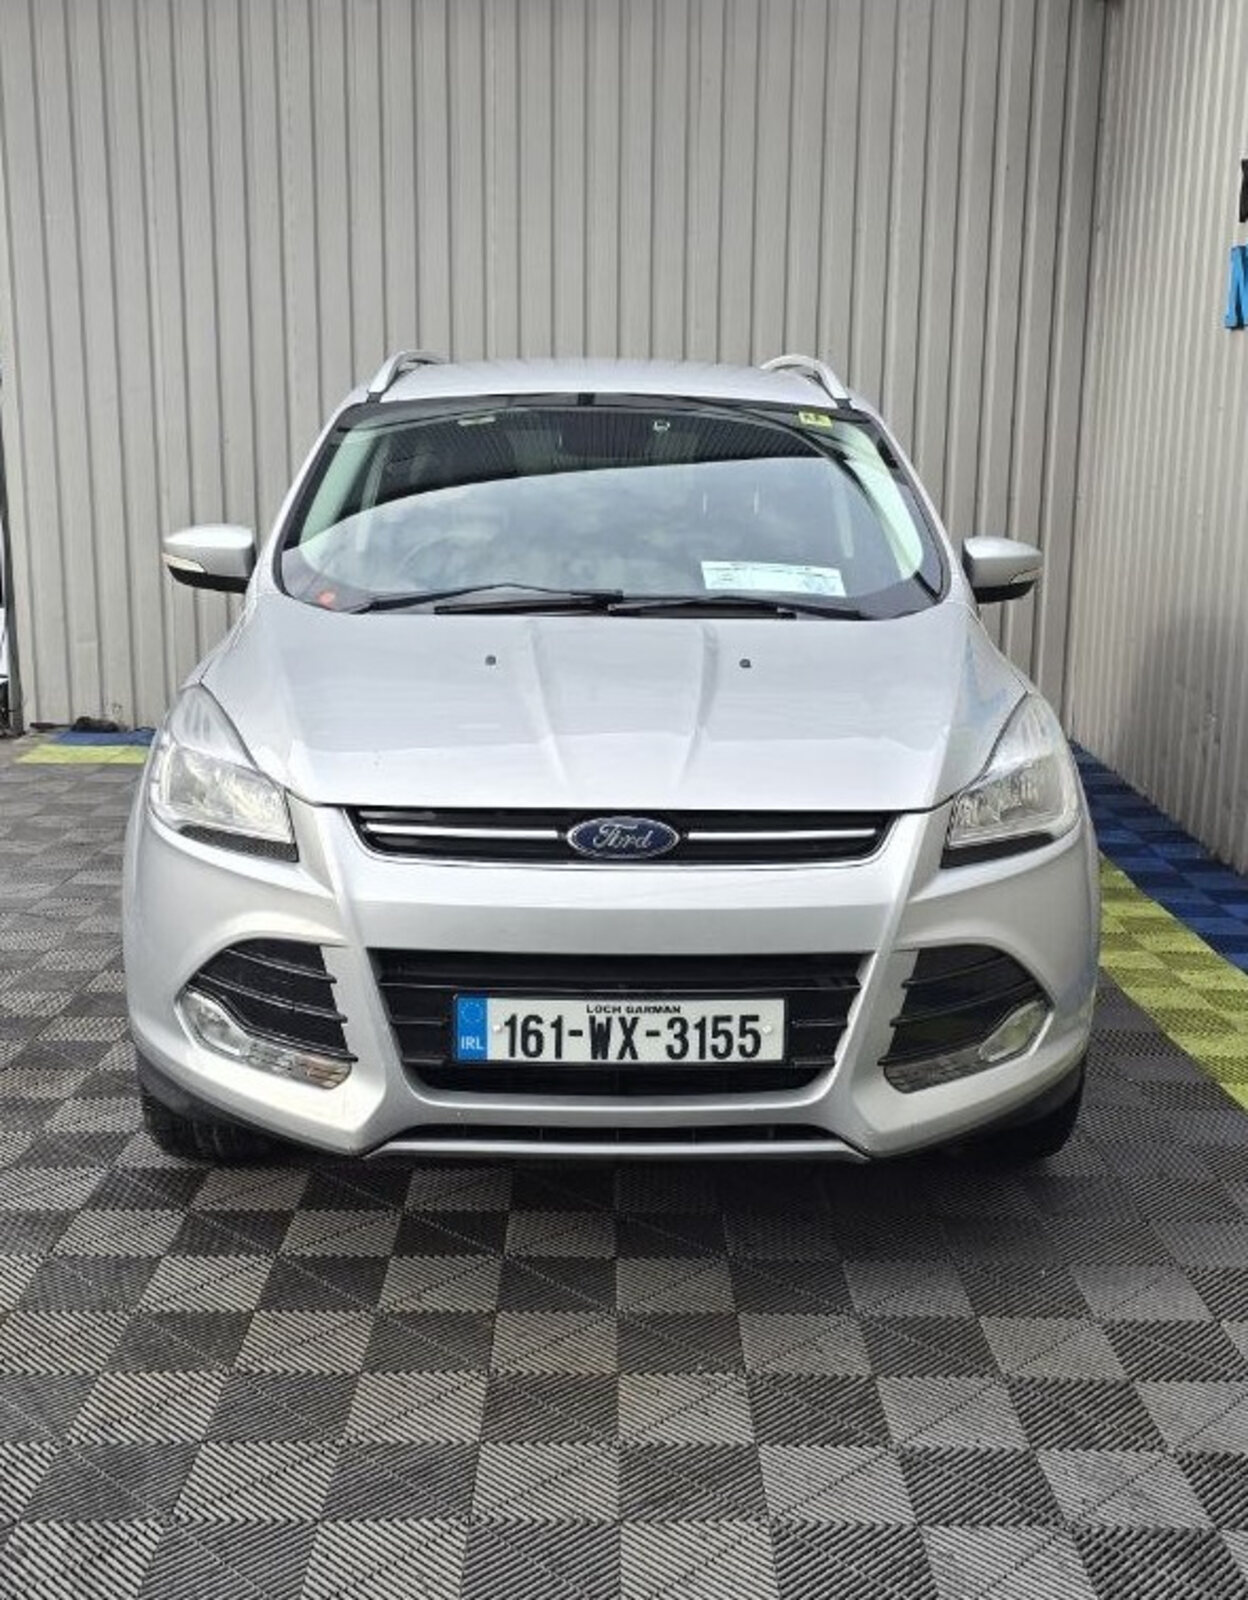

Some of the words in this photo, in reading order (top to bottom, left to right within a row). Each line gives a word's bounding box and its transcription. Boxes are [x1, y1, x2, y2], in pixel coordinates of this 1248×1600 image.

[593, 824, 654, 849] Ford
[586, 1004, 622, 1014] LOCH
[626, 1004, 682, 1014] GARMAN
[461, 1035, 484, 1050] IRL
[503, 1013, 762, 1061] 161-WX-3155
